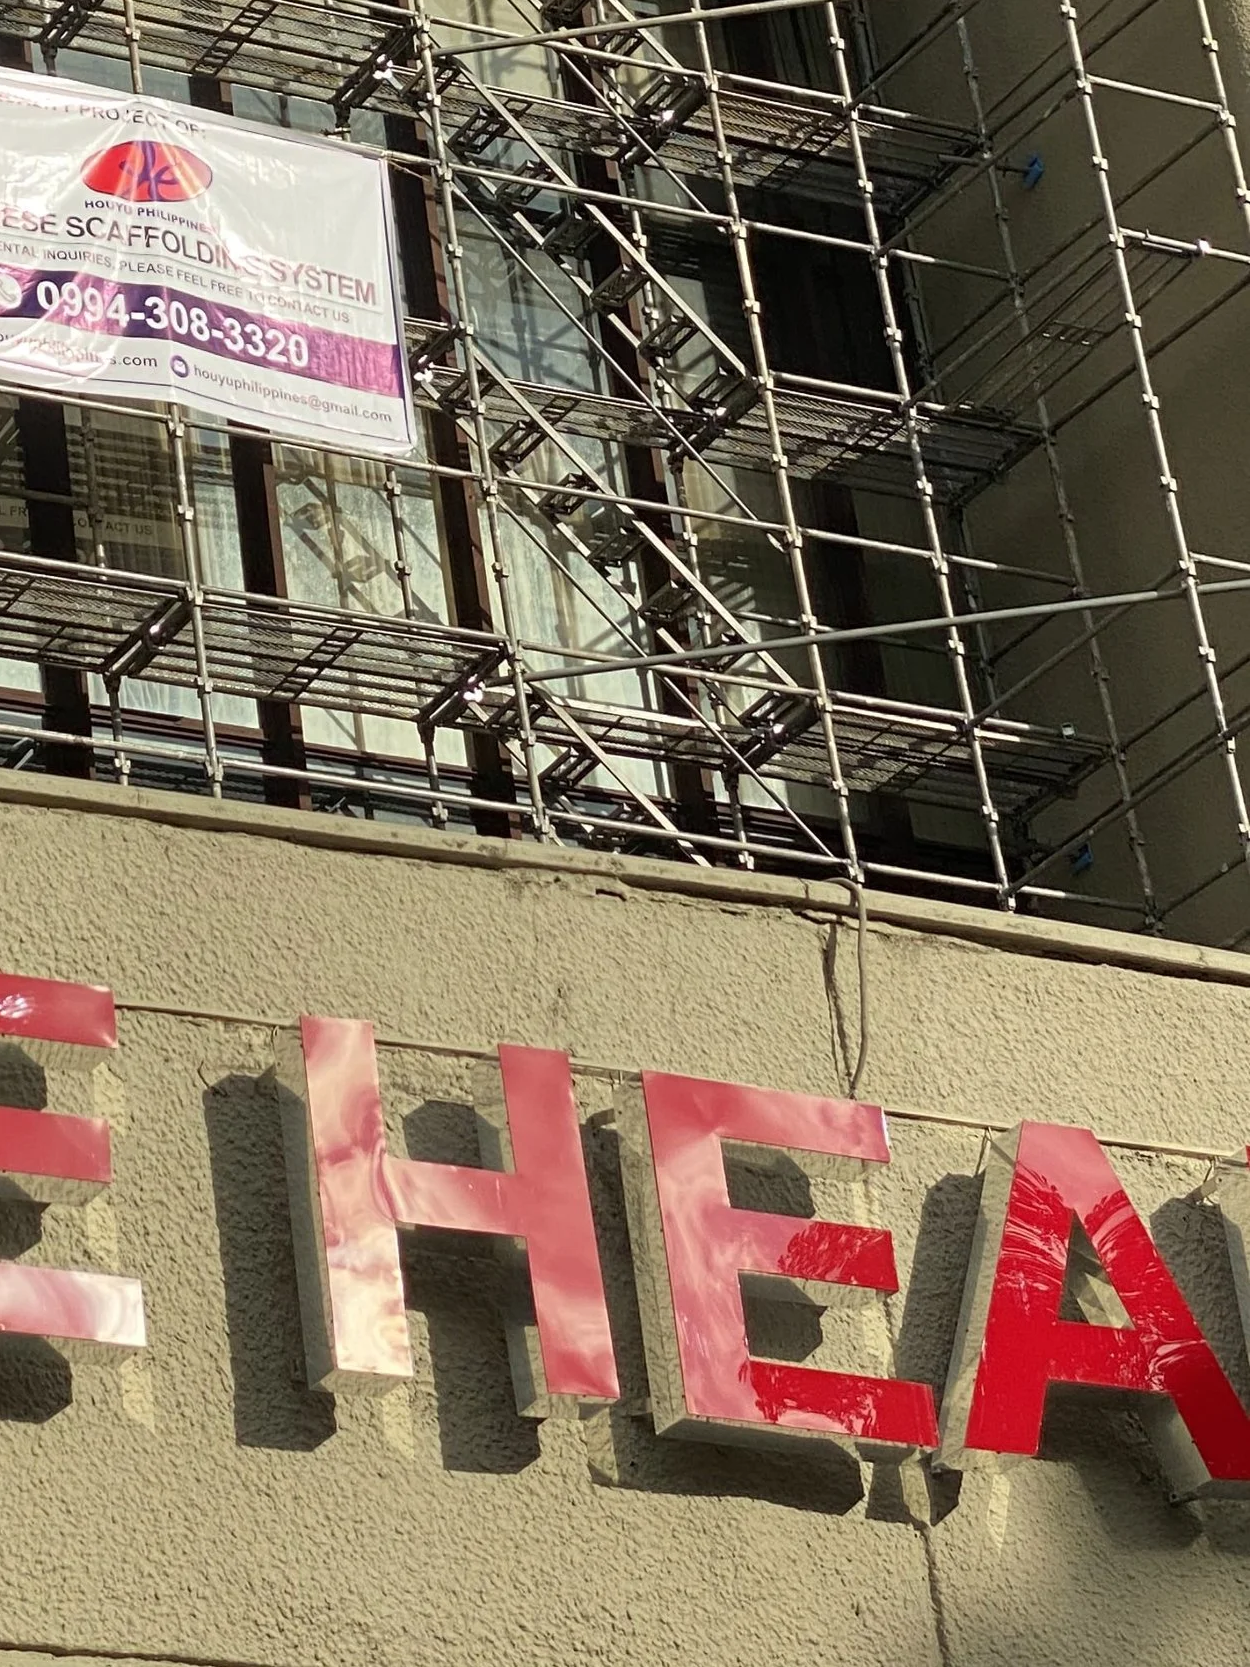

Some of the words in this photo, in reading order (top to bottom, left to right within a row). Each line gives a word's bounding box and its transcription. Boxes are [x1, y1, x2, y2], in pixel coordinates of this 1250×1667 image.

[79, 106, 169, 131] PROJECT
[85, 200, 132, 215] HOUYU
[65, 215, 266, 277] SCAFFOLDING
[268, 257, 377, 307] SYSTEM
[119, 261, 174, 278] PLEASE
[176, 269, 210, 288] FEEL
[211, 279, 243, 299] FREE
[267, 295, 328, 319] CONTACT
[332, 310, 350, 324] US
[37, 281, 309, 367] 0994-308-3320
[194, 365, 392, 423] houyuphilippines@gmail.com
[301, 1015, 1250, 1481] HEA
